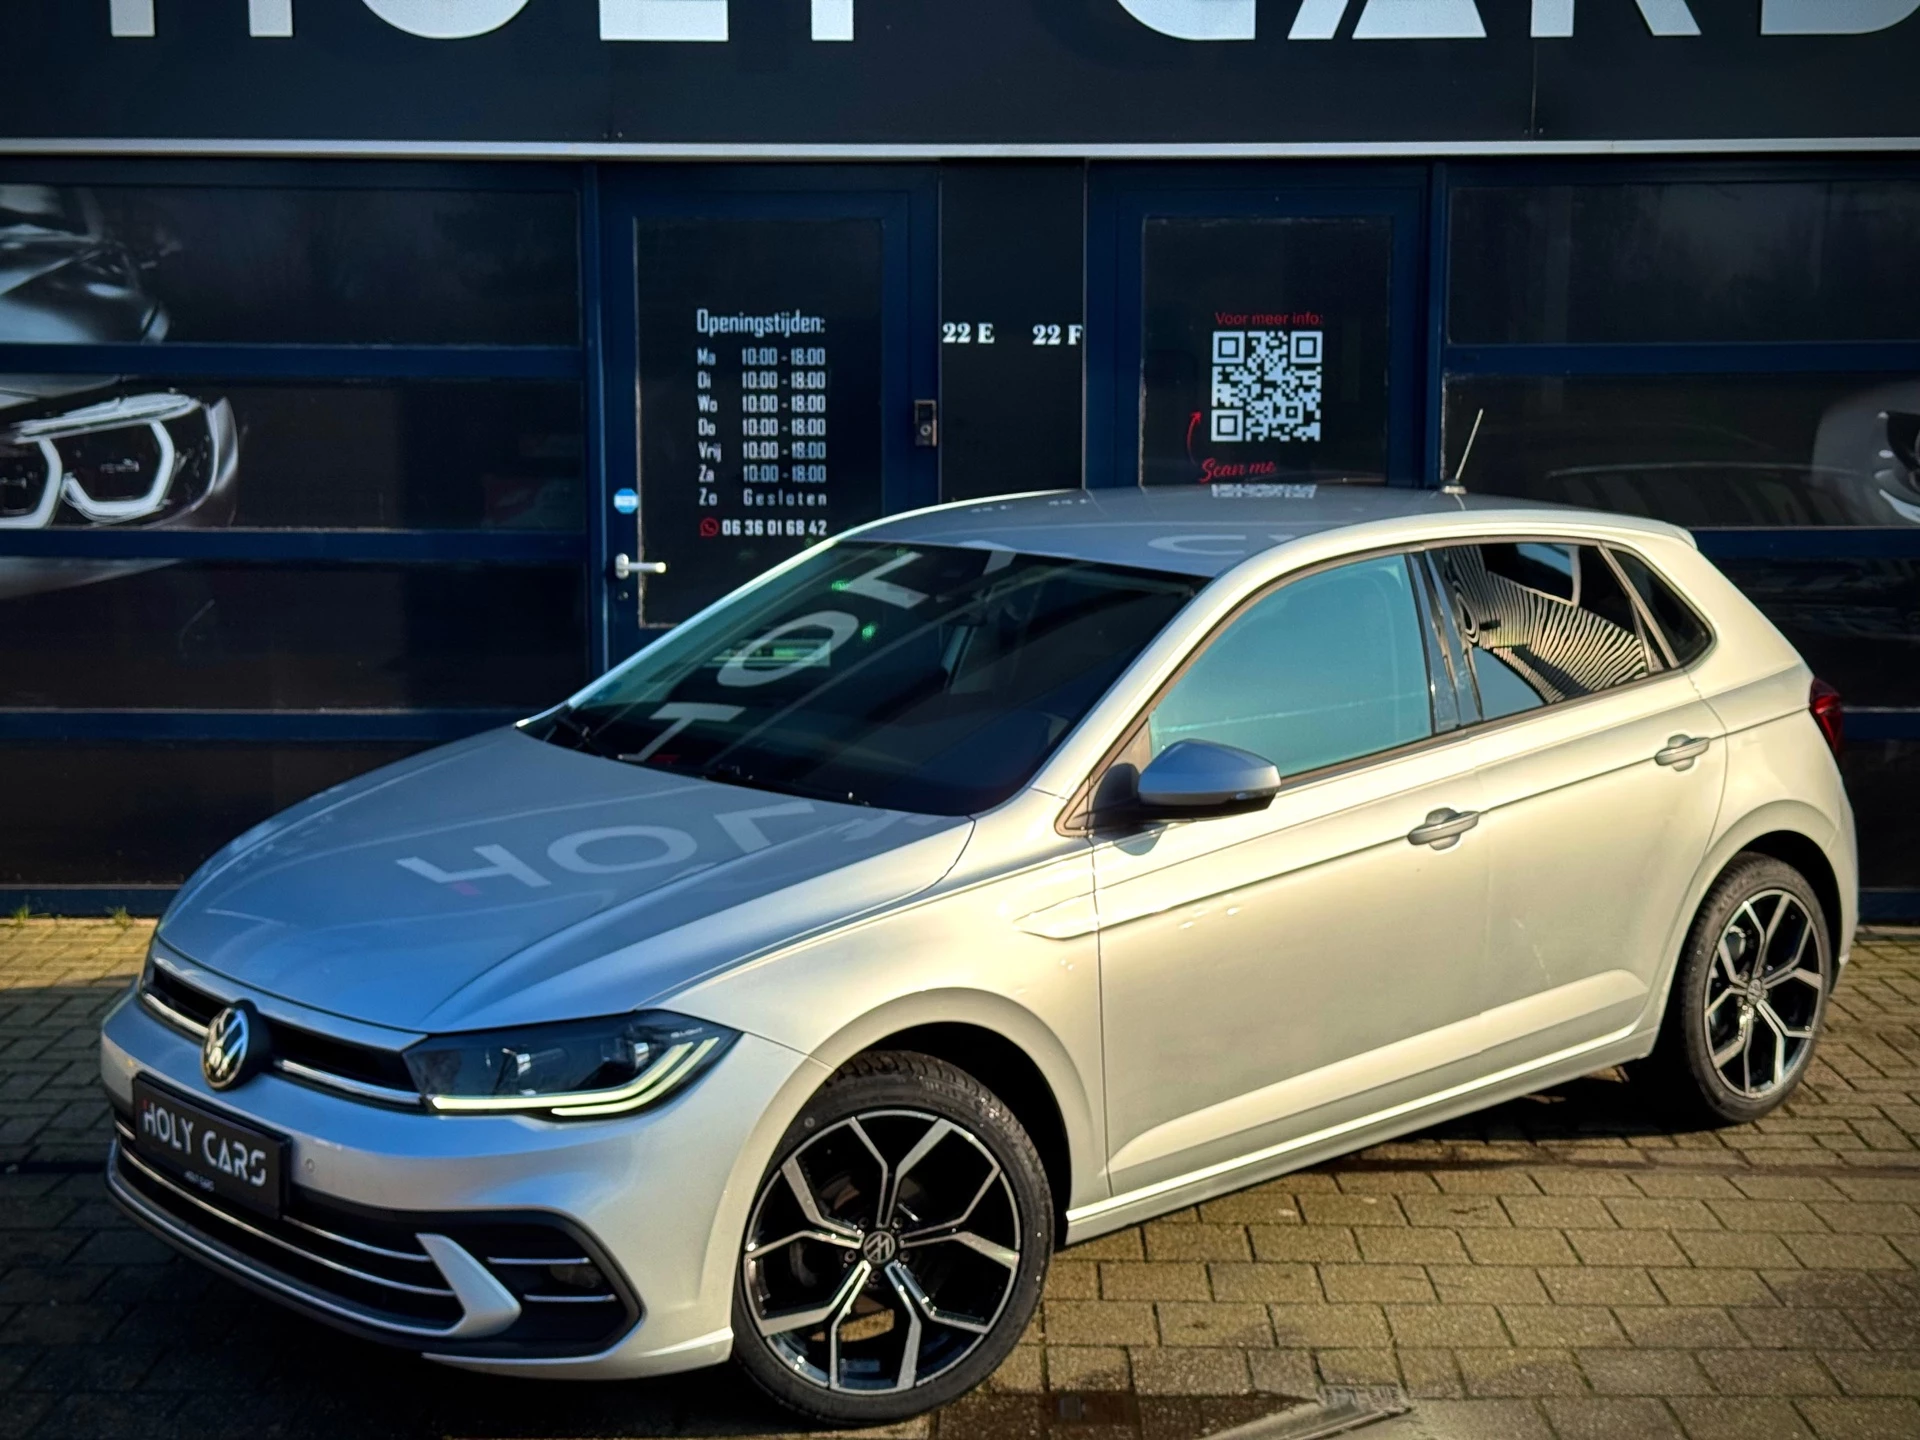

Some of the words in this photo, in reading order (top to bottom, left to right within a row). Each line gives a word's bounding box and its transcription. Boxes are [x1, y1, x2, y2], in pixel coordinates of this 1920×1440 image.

[696, 308, 825, 338] Openingstijden:
[1214, 312, 1248, 326] Voor
[1251, 314, 1289, 325] meer
[1292, 311, 1324, 326] info:
[942, 322, 971, 343] 22
[977, 323, 995, 344] E
[1032, 324, 1062, 345] 22
[1068, 324, 1083, 345] F
[697, 348, 716, 366] Ma
[742, 348, 778, 366] 10:00
[791, 348, 826, 366] 18:00
[698, 371, 712, 389] Di
[742, 371, 778, 389] 10:00
[791, 371, 826, 389] 18:00
[697, 395, 718, 413] Wo
[742, 395, 778, 413] 10:00
[791, 395, 826, 413] 18:00
[698, 418, 716, 436] Do
[742, 418, 778, 436] 10:00
[791, 418, 826, 436] 18:00
[698, 441, 722, 463] Vrij
[742, 441, 778, 459] 10:00
[791, 441, 826, 459] 18:00
[698, 464, 715, 483] Za
[742, 464, 778, 483] 10:00
[791, 464, 826, 483] 18:00
[1199, 457, 1245, 483] Scan
[1248, 461, 1277, 474] me
[699, 487, 718, 506] Zo
[722, 519, 741, 536] 06
[744, 519, 764, 536] 36
[767, 519, 783, 536] 01
[785, 519, 805, 536] 68
[808, 519, 827, 536] 42
[142, 1099, 194, 1155] HOLY
[202, 1129, 267, 1187] CARS
